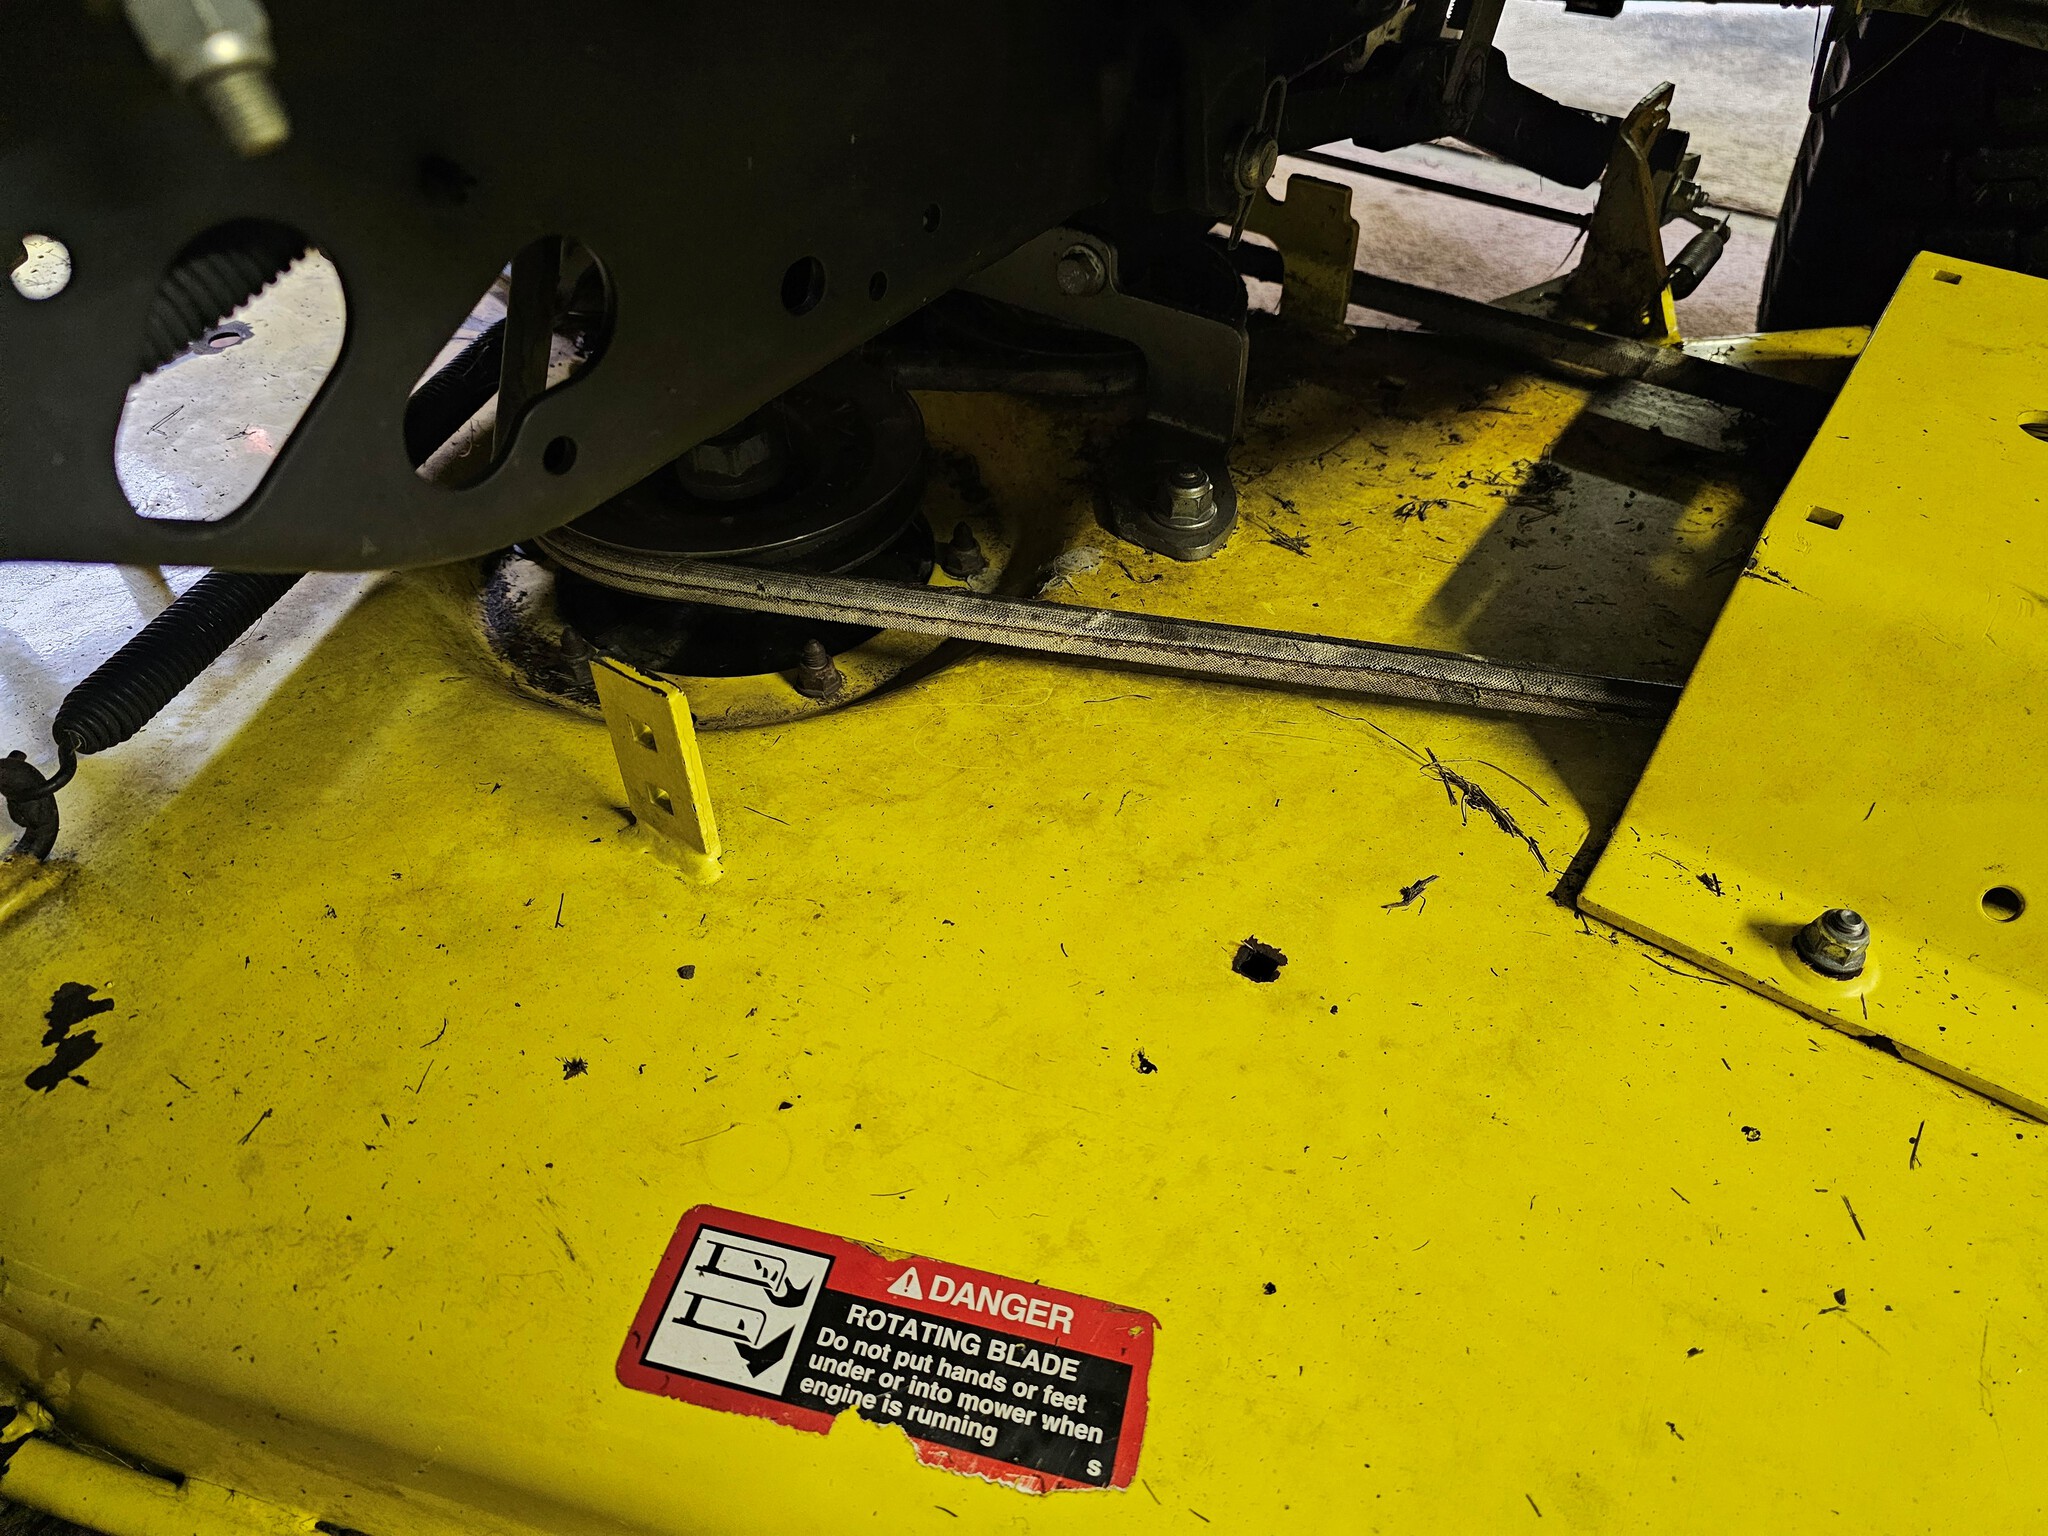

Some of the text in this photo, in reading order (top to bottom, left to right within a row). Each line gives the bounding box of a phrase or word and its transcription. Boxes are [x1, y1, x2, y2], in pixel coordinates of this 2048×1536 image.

[846, 1304, 1080, 1381] ROTATING BLADE
[928, 1275, 1075, 1334] DANGER
[809, 1354, 1104, 1444] under or into mower when
[816, 1327, 1087, 1413] Do not put hands or feet
[800, 1377, 998, 1447] engine is running
